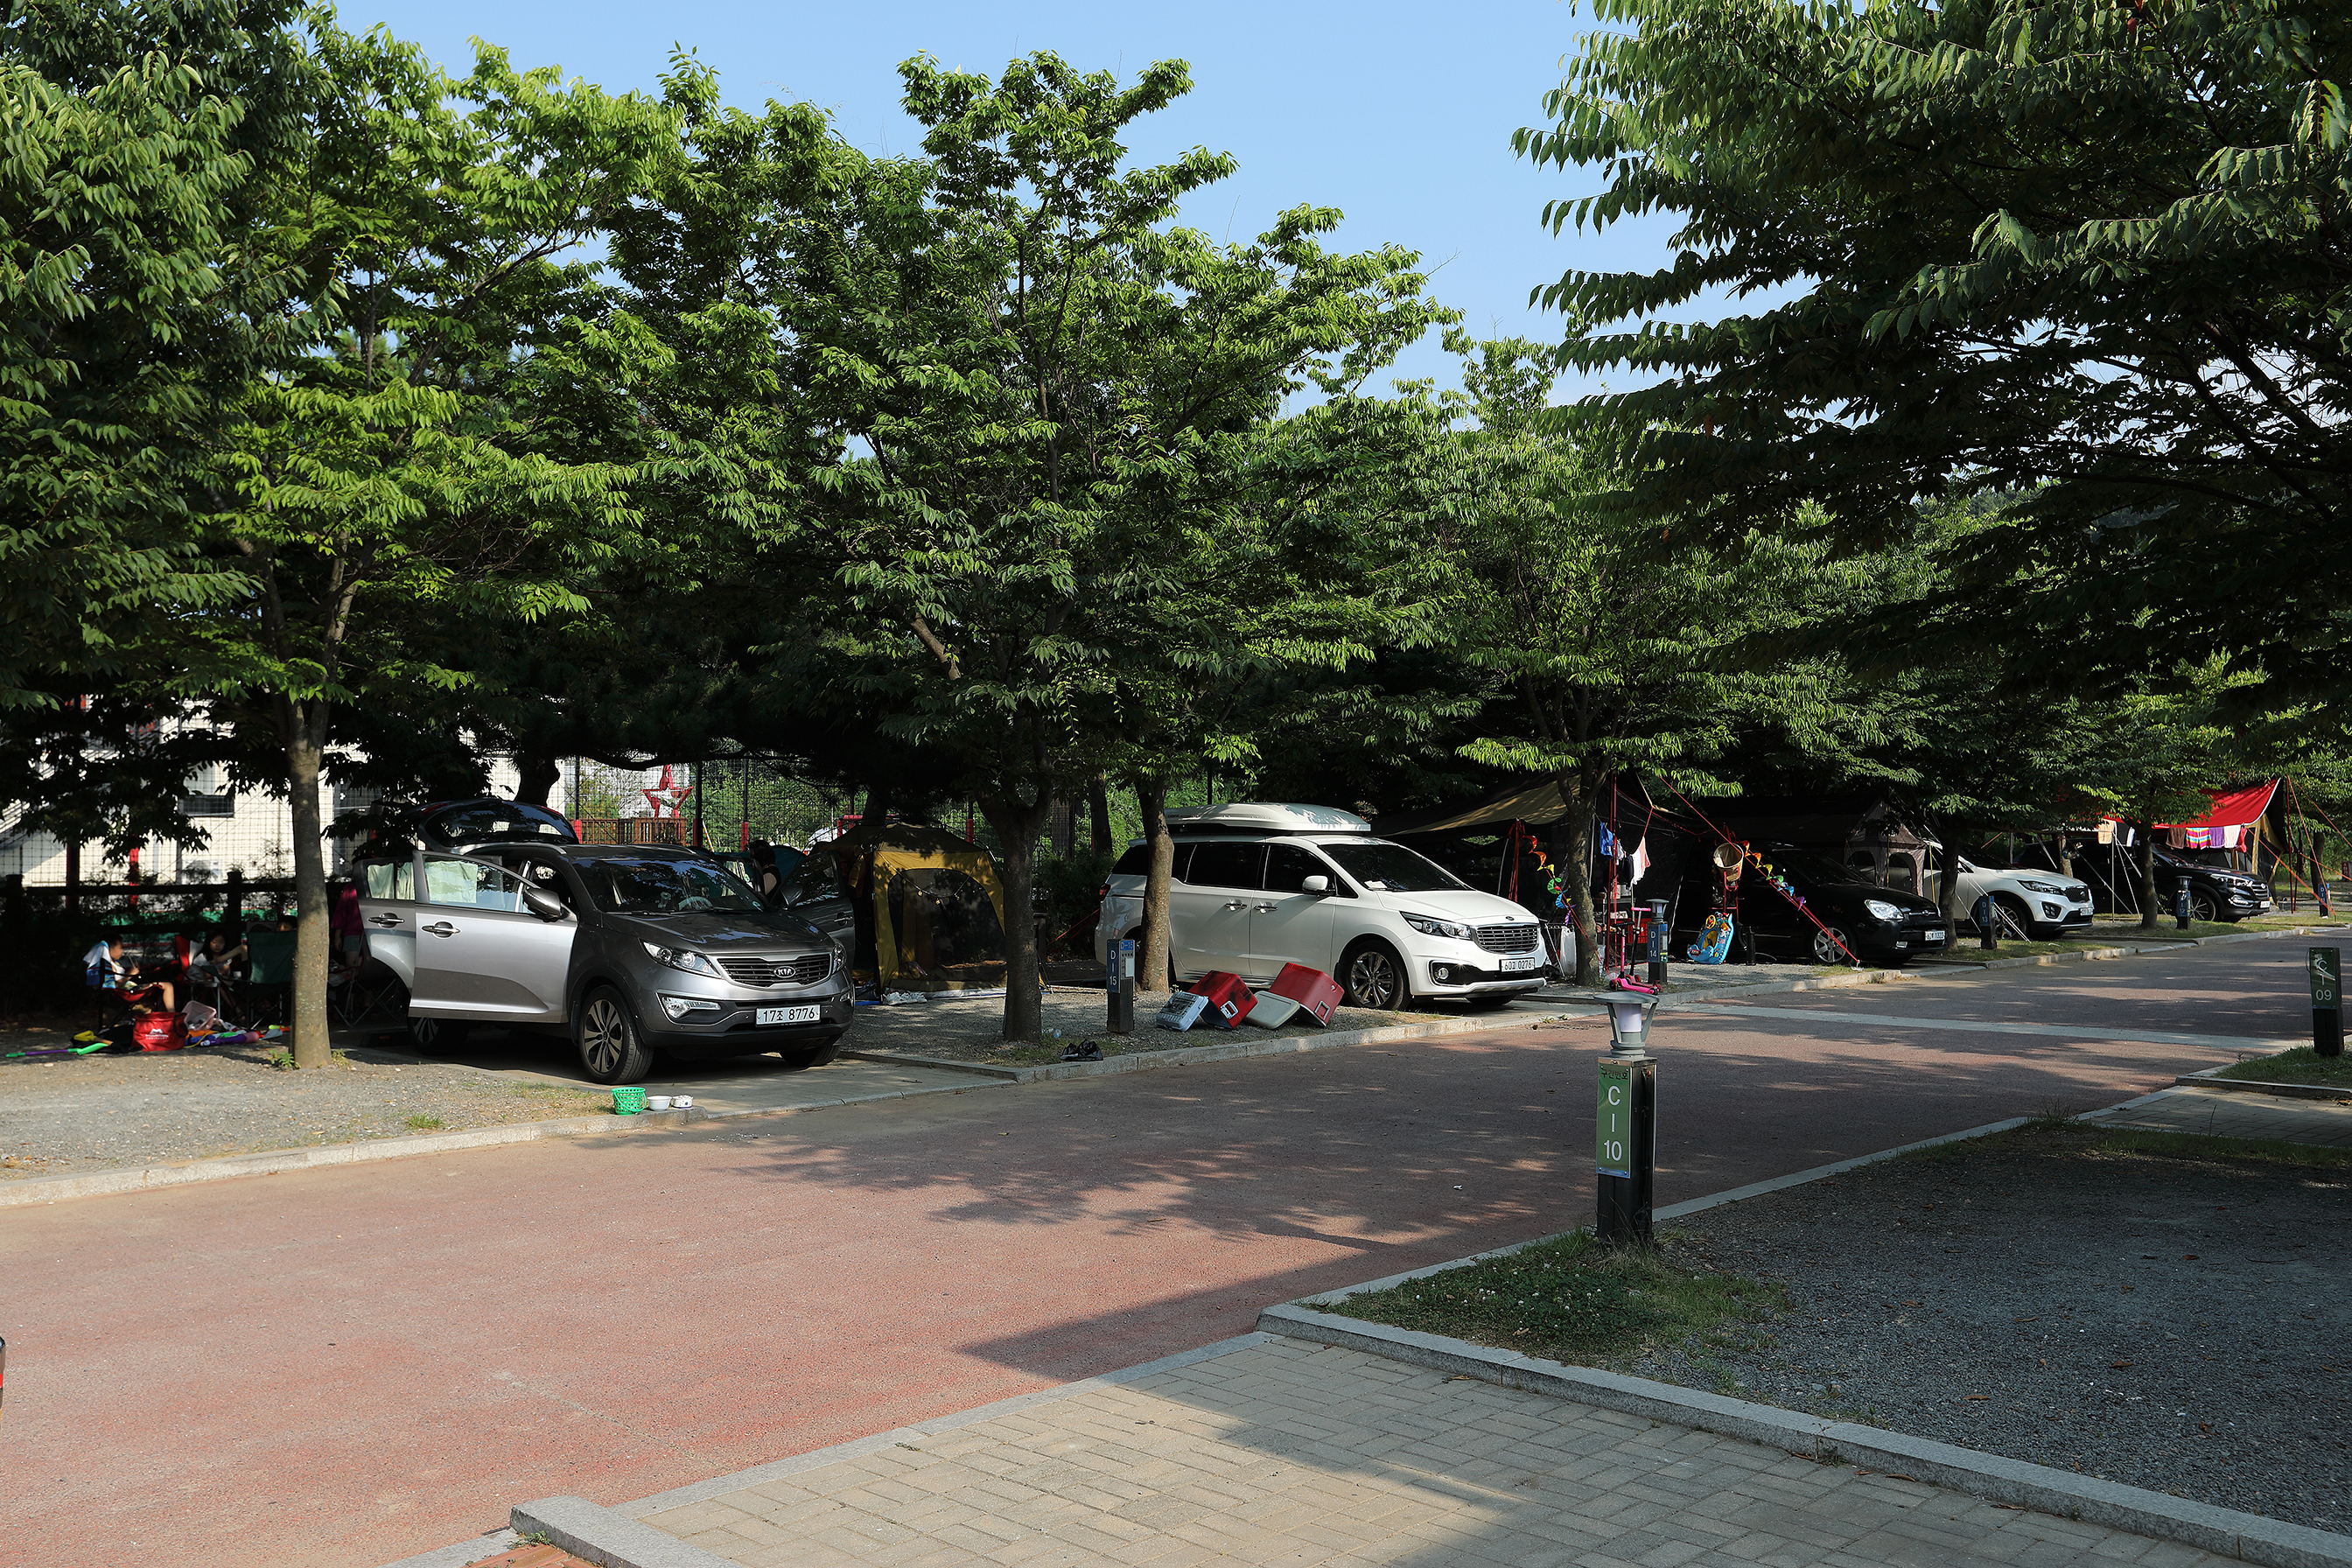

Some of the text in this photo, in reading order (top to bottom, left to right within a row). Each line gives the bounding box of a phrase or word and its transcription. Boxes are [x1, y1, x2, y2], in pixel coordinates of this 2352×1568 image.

[1110, 949, 1116, 960] D
[1517, 960, 1532, 970] 0276
[1110, 976, 1117, 986] 15
[2315, 989, 2333, 1001] 09
[763, 1007, 816, 1023] 17조 8776
[1607, 1085, 1620, 1106] C
[1603, 1139, 1622, 1161] 10
